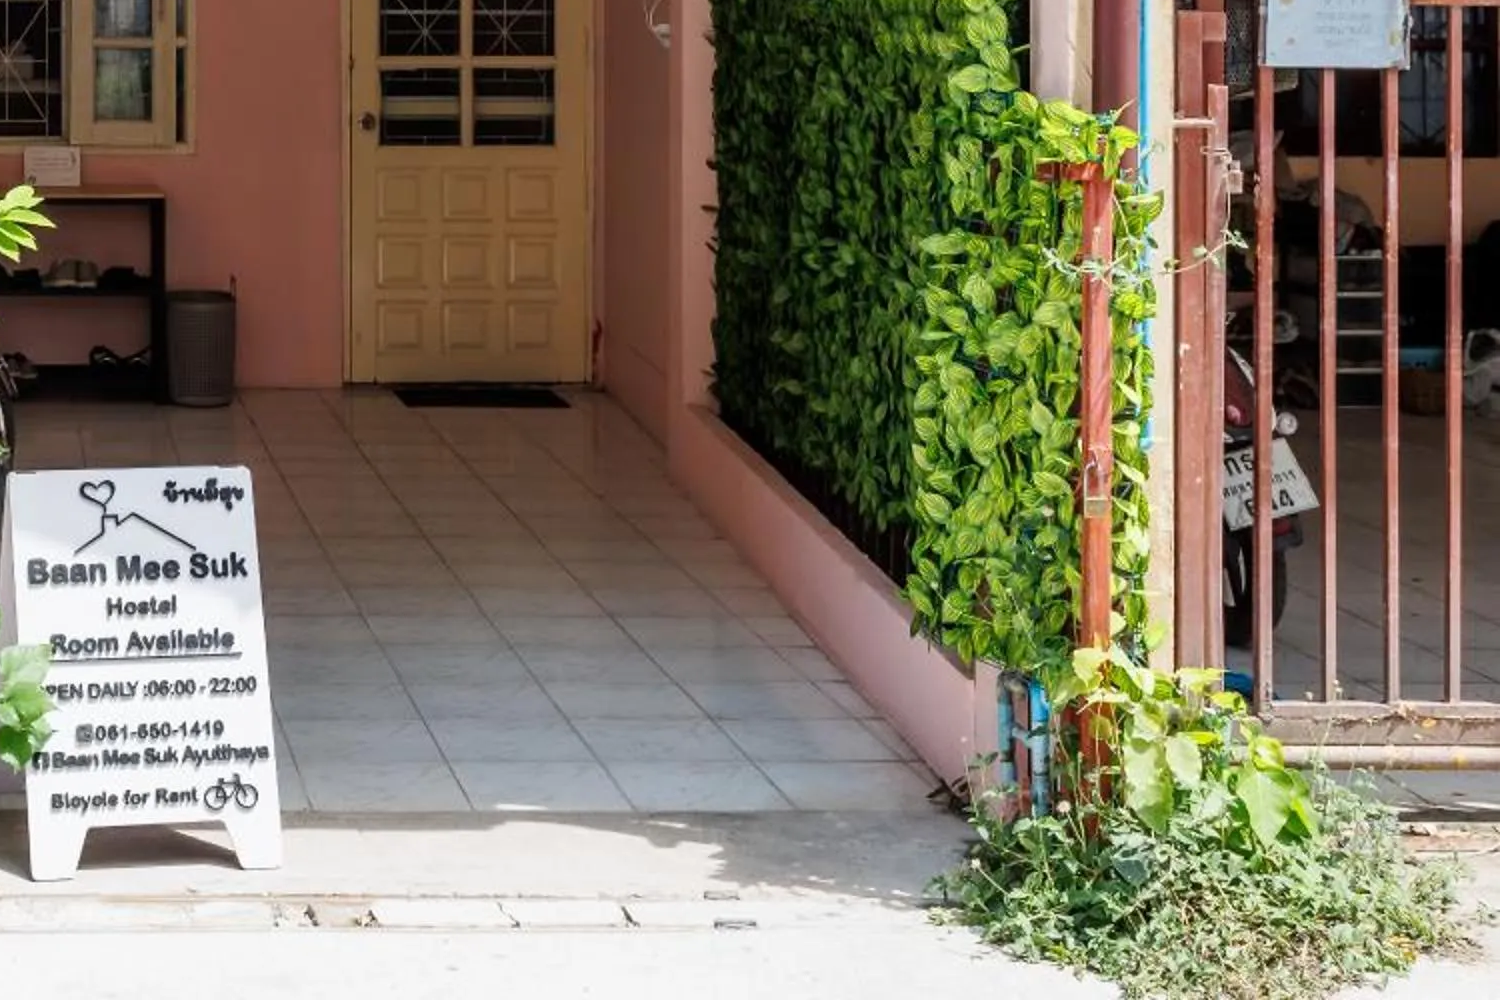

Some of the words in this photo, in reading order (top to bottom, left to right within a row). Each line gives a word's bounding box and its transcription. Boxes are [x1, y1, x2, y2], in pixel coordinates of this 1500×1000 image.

[27, 558, 106, 585] Baan
[116, 555, 181, 581] Mee
[189, 552, 248, 578] Suk
[106, 595, 177, 616] Hostel
[50, 634, 119, 655] Room
[126, 627, 235, 651] Available
[41, 682, 84, 700] PEN
[87, 680, 139, 699] DAILY
[209, 676, 257, 694] 22:00
[52, 751, 99, 769] Baan
[102, 749, 140, 766] Mee
[143, 747, 178, 764] Suk
[182, 744, 269, 766] Ayutthaya
[51, 792, 118, 814] Bicycle
[124, 790, 150, 805] for
[155, 788, 198, 805] Rent
